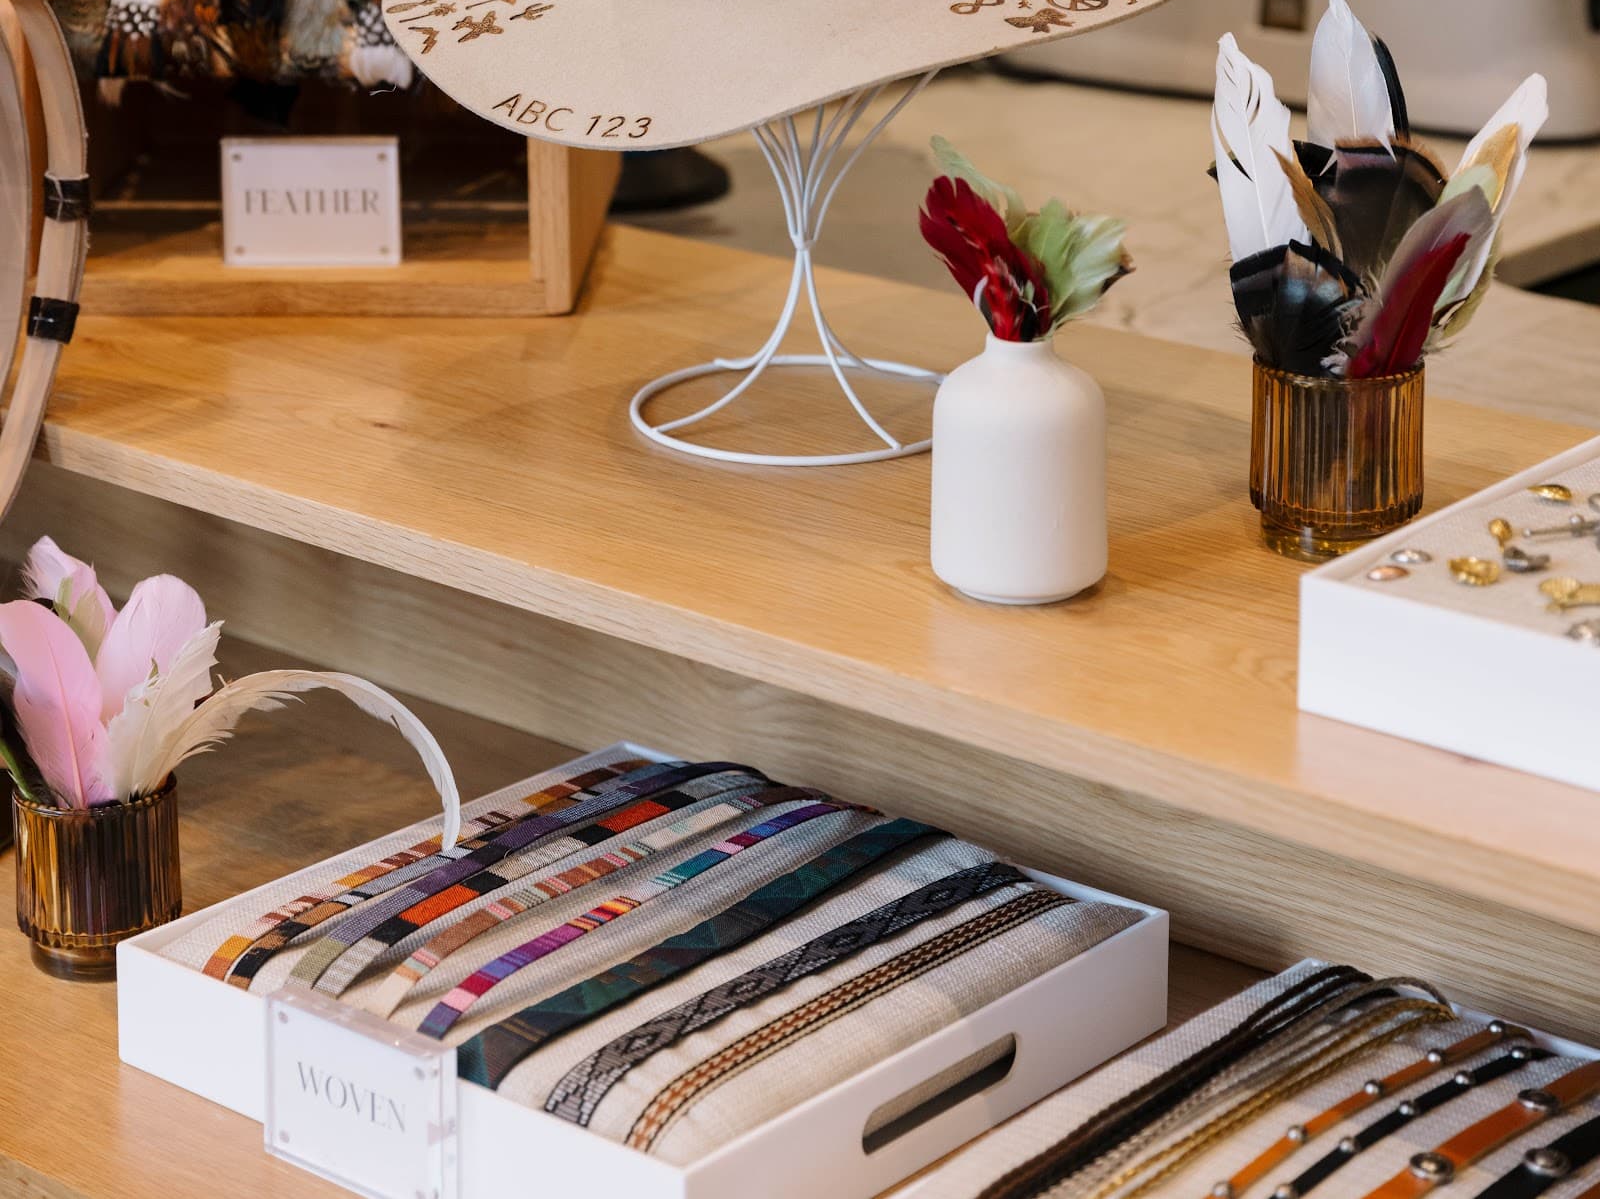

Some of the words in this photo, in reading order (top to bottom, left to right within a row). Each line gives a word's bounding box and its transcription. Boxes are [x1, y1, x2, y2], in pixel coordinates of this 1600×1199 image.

[491, 93, 574, 132] ABC
[586, 114, 652, 139] 123
[244, 188, 380, 216] FEATHER
[297, 1061, 406, 1133] WOVEN
